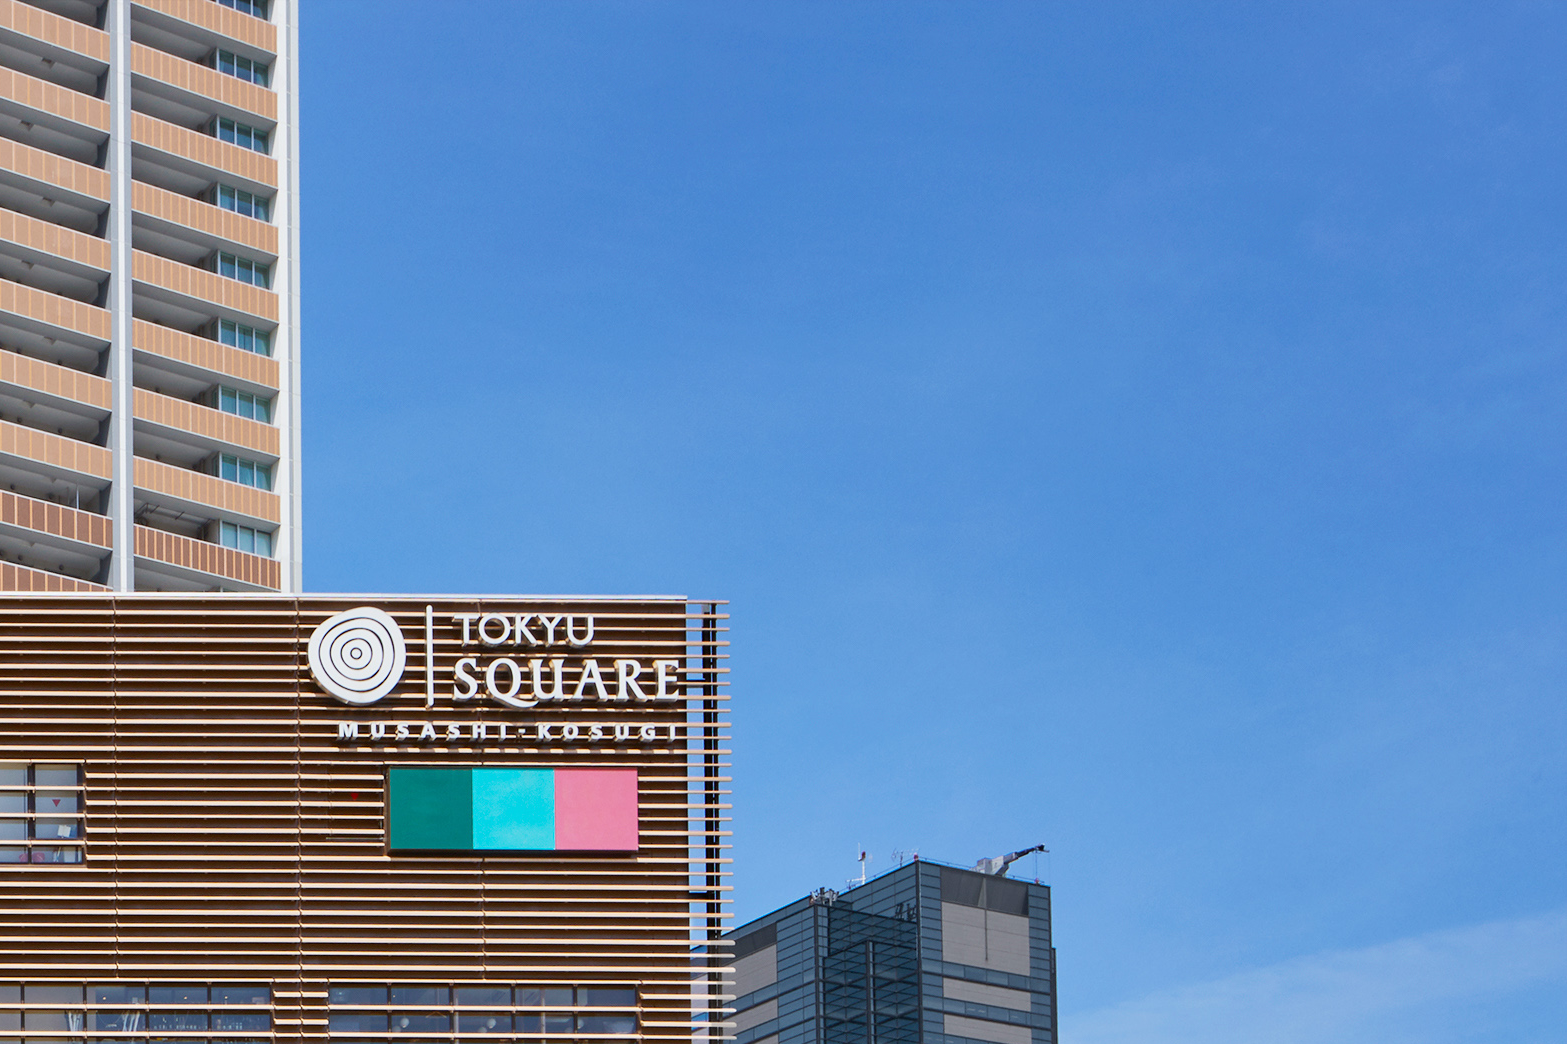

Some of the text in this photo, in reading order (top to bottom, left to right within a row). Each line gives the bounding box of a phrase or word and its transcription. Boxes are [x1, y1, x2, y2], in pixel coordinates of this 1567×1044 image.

[452, 613, 596, 647] TOKYU
[453, 657, 681, 708] SQUARE
[336, 721, 677, 742] MUSASHI-KOSUGI
